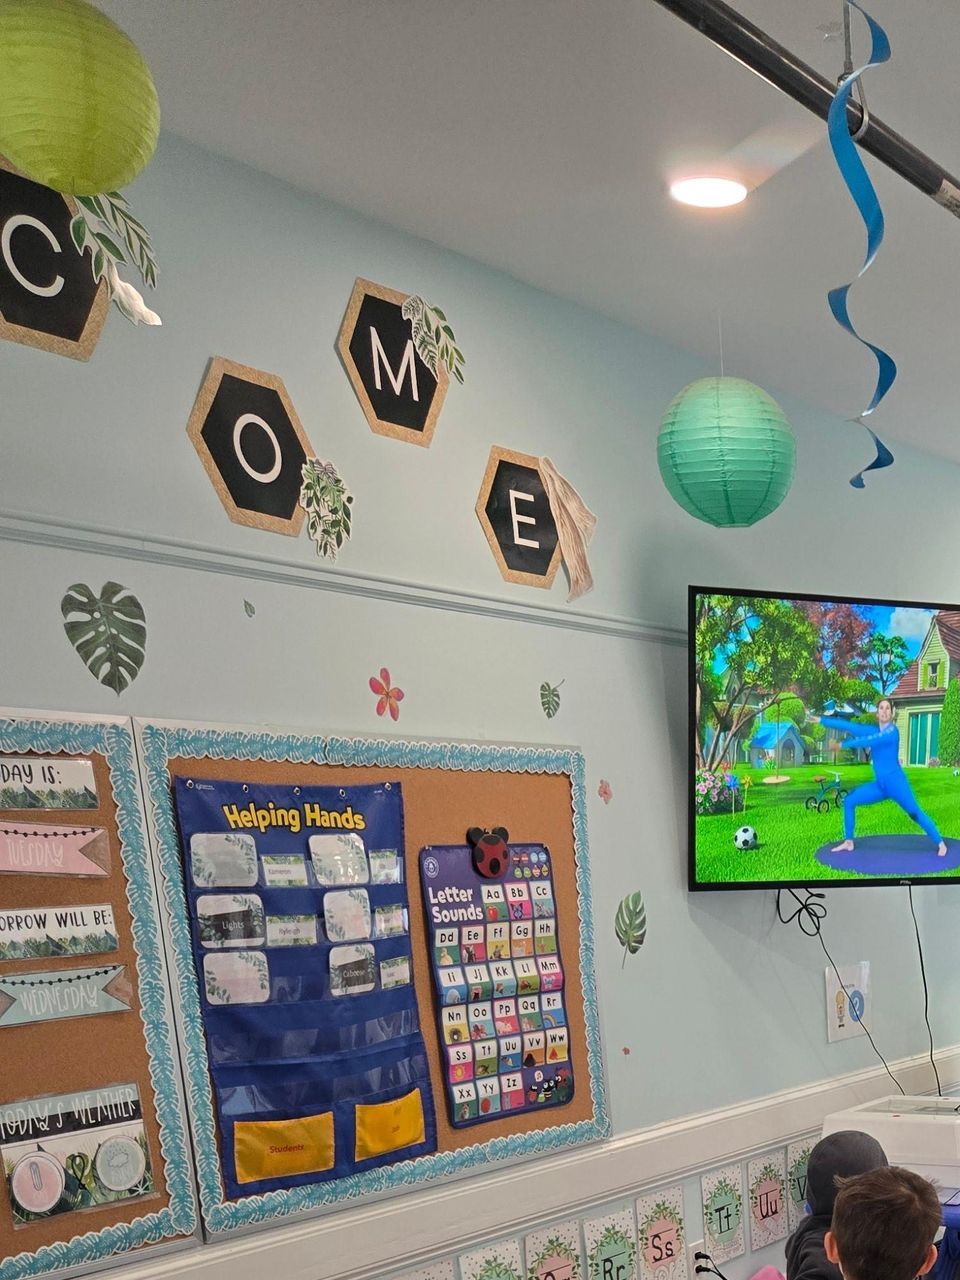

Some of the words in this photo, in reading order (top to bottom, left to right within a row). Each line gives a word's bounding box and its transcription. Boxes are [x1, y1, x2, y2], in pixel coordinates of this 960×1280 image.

[42, 765, 62, 785] IS:
[222, 801, 301, 833] Helping
[304, 802, 366, 830] Hands
[7, 838, 64, 867] TUESDAY
[428, 886, 473, 904] Letter
[487, 889, 499, 899] Aa
[511, 887, 524, 898] Bb
[536, 886, 547, 896] Cc
[55, 911, 88, 928] WILL
[93, 909, 112, 927] BE:
[432, 904, 484, 923] Sounds
[222, 920, 245, 931] Lights
[540, 923, 551, 934] Hh
[467, 930, 479, 940] Ee
[494, 928, 503, 938] Ff
[516, 926, 528, 937] Gg
[440, 932, 454, 943] Dd
[541, 960, 557, 970] Mm
[473, 969, 483, 981] Jj
[495, 966, 508, 977] Kk
[20, 982, 98, 1017] WEDNESDAY
[522, 1000, 536, 1010] Qq
[547, 997, 556, 1007] Rr
[473, 1008, 487, 1017] Oo
[500, 1004, 511, 1014] Pp
[448, 1011, 461, 1022] Nn
[529, 1038, 541, 1047] Vv
[550, 1033, 565, 1043] Ww
[482, 1045, 491, 1055] Tt
[505, 1041, 517, 1051] Uu
[456, 1051, 467, 1061] Ss
[507, 1078, 517, 1088] Zz
[458, 1089, 472, 1100] Xx
[482, 1084, 494, 1094] Yy
[72, 1088, 136, 1125] WEATHER
[269, 1143, 304, 1154] Students
[759, 1192, 779, 1219] Uu
[715, 1203, 734, 1235] Tt
[651, 1233, 675, 1263] Ss
